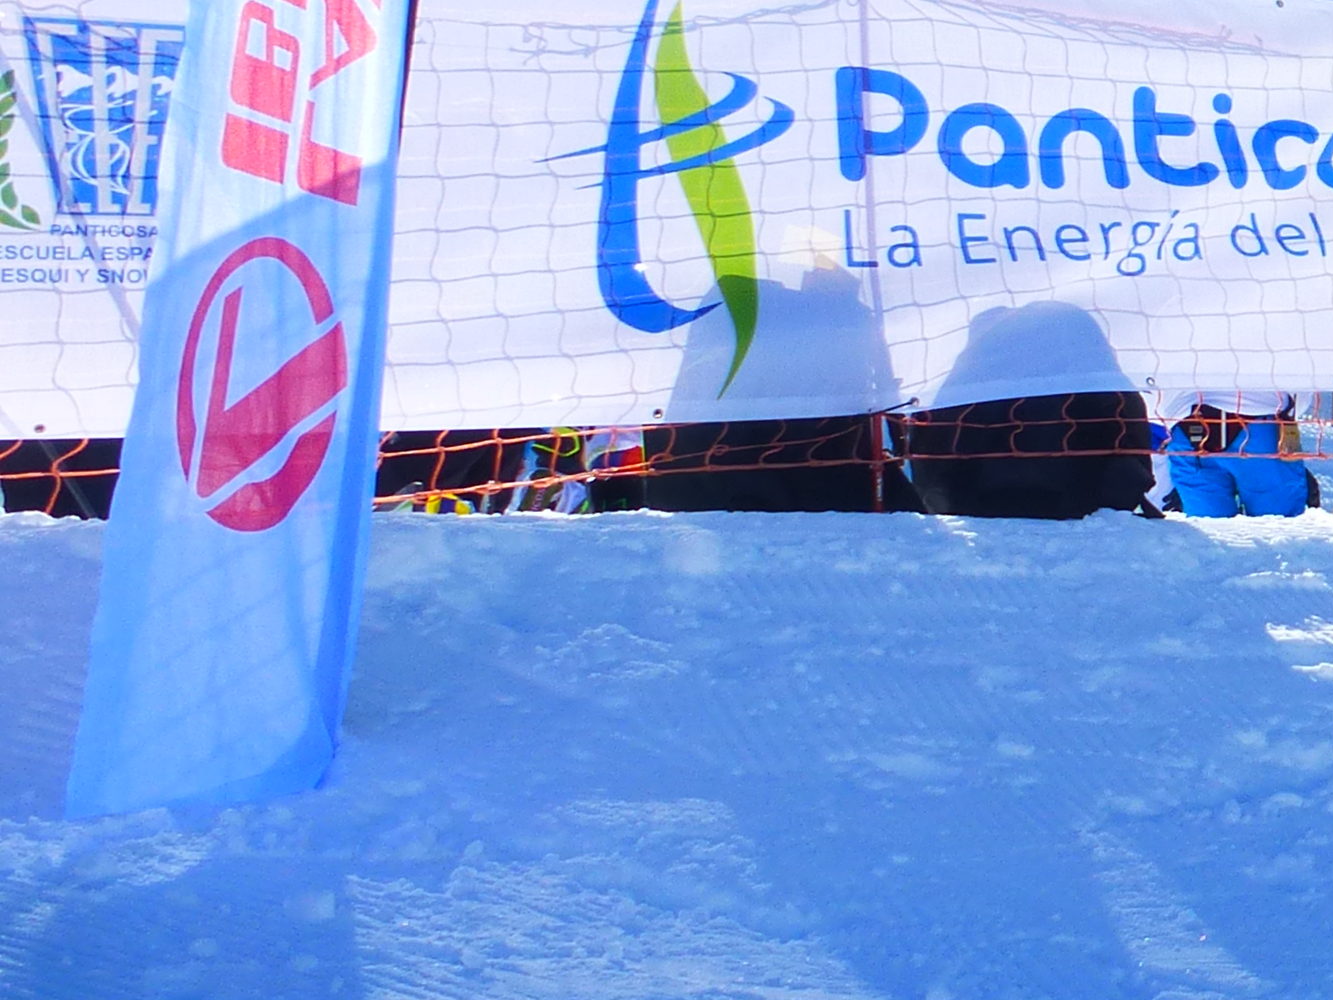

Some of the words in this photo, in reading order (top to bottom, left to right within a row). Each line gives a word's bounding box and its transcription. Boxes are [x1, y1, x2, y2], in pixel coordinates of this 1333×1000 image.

[50, 223, 158, 238] PANTICOSA
[844, 209, 922, 268] La
[957, 209, 1202, 277] Energía
[1230, 212, 1327, 258] del
[0, 245, 95, 261] SCUELA
[1, 268, 69, 284] ESQUI
[76, 269, 90, 283] Y
[97, 269, 148, 284] SNO
